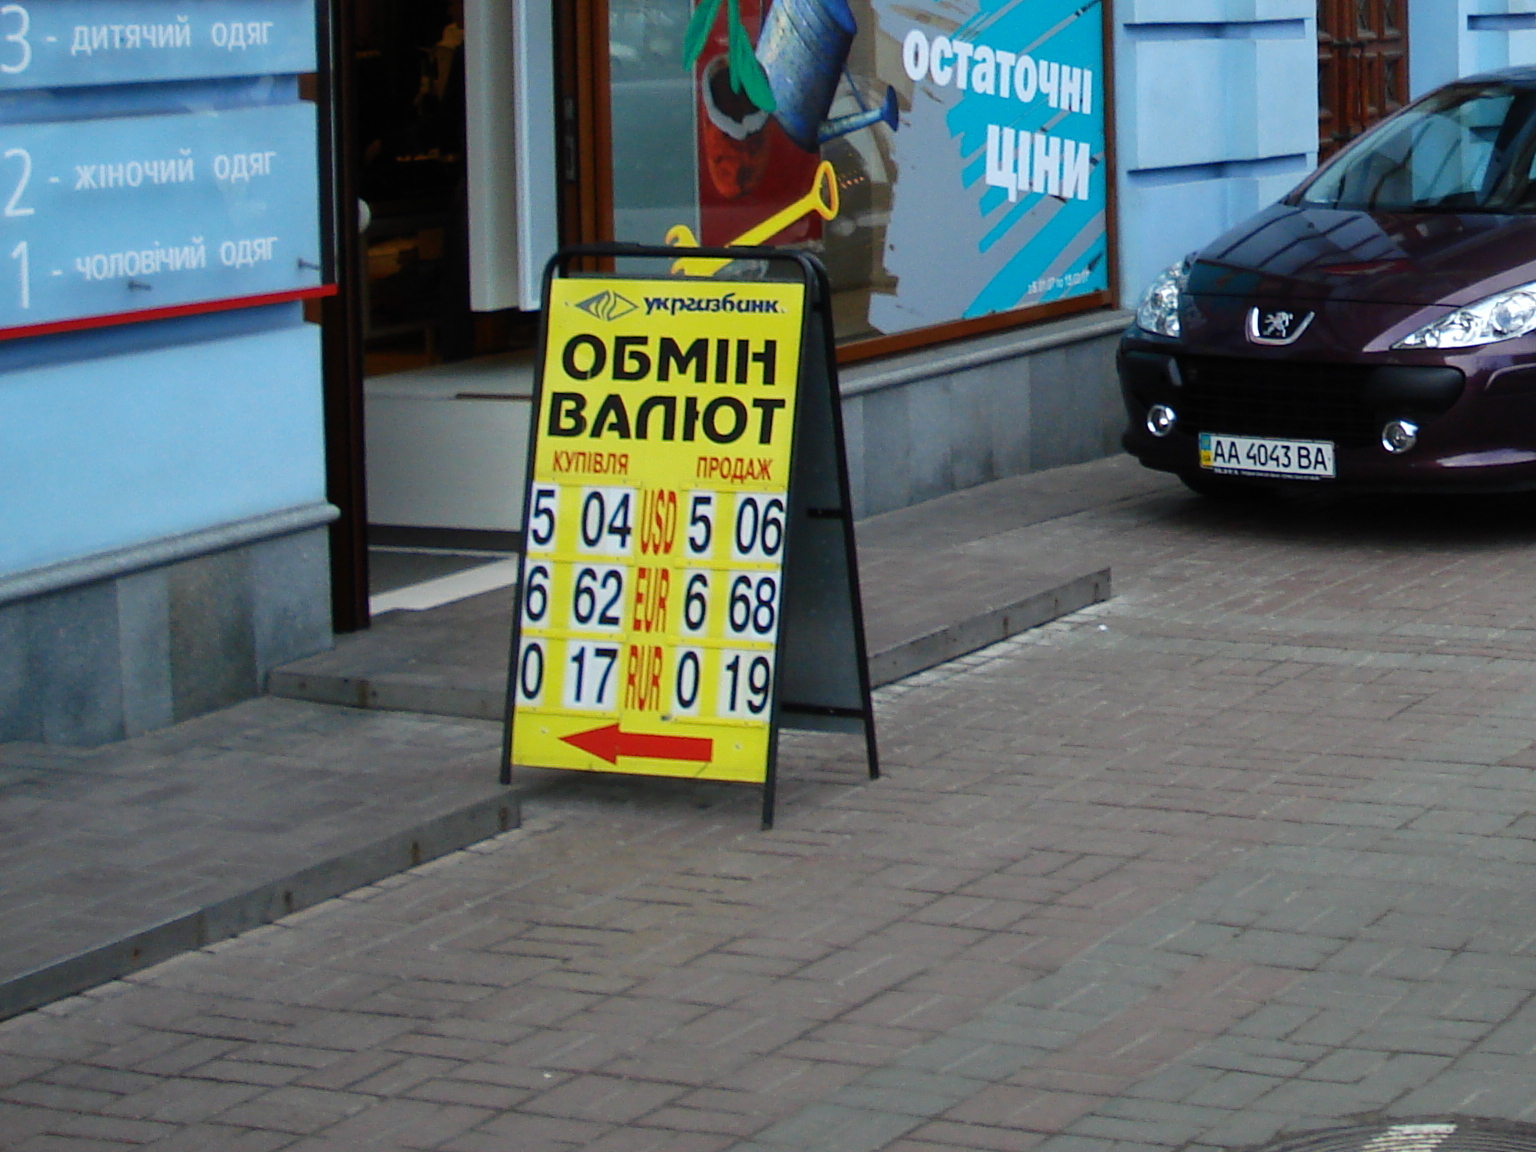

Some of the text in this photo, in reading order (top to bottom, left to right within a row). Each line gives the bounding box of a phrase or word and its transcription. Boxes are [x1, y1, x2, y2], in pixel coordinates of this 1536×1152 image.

[0, 4, 32, 74] 3
[71, 15, 192, 56] дитячий
[211, 21, 274, 48] одяг
[3, 149, 35, 217] 2
[75, 148, 194, 191] жіночий
[214, 150, 278, 180] одяг
[8, 241, 31, 309] 1
[76, 236, 206, 281] чоловічий
[220, 236, 279, 268] одяг
[561, 333, 778, 386] ОБМІН
[547, 391, 786, 444] ВАЛЮТ
[552, 450, 774, 483] КУПІВЛЯ ПРОДАЖ
[1213, 440, 1328, 471] AA 4043 BA
[531, 488, 785, 557] 5 04 USD 5 06
[526, 565, 776, 635] 6 62 EUR 6 68
[521, 642, 771, 714] 0 17 RUR 0 19
